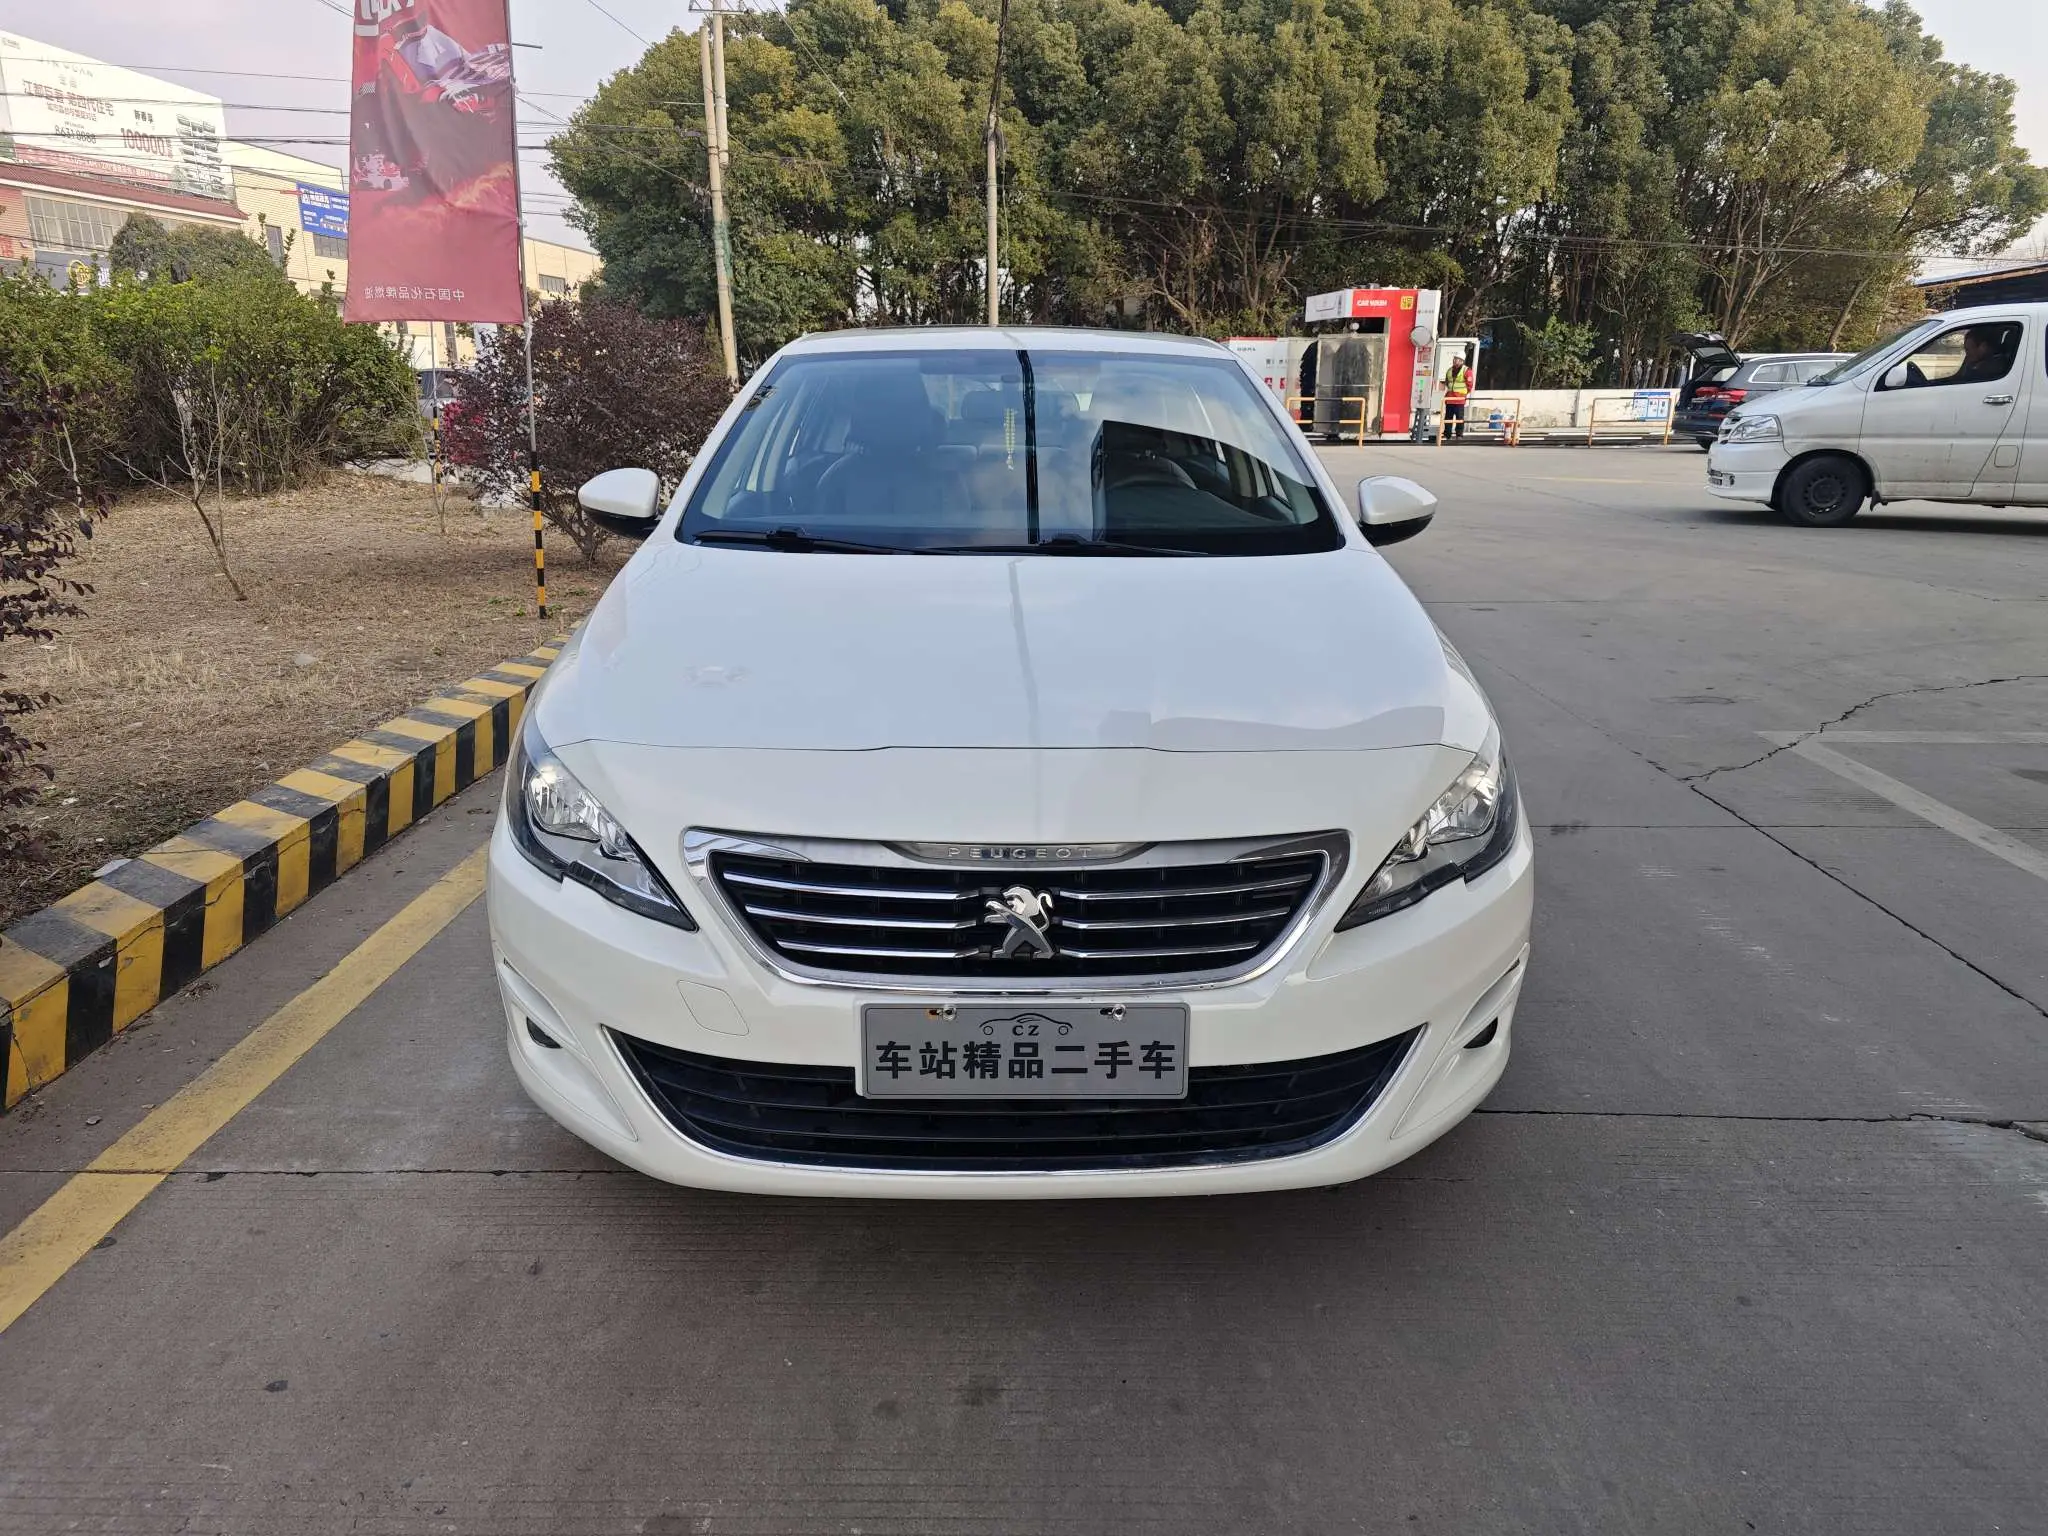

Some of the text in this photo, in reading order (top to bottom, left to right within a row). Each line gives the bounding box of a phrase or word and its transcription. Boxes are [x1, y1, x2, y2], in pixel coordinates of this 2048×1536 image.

[948, 847, 1093, 859] PEUGEOT
[1012, 1024, 1040, 1037] CZ
[875, 1040, 1176, 1080] 车站精品二手车
